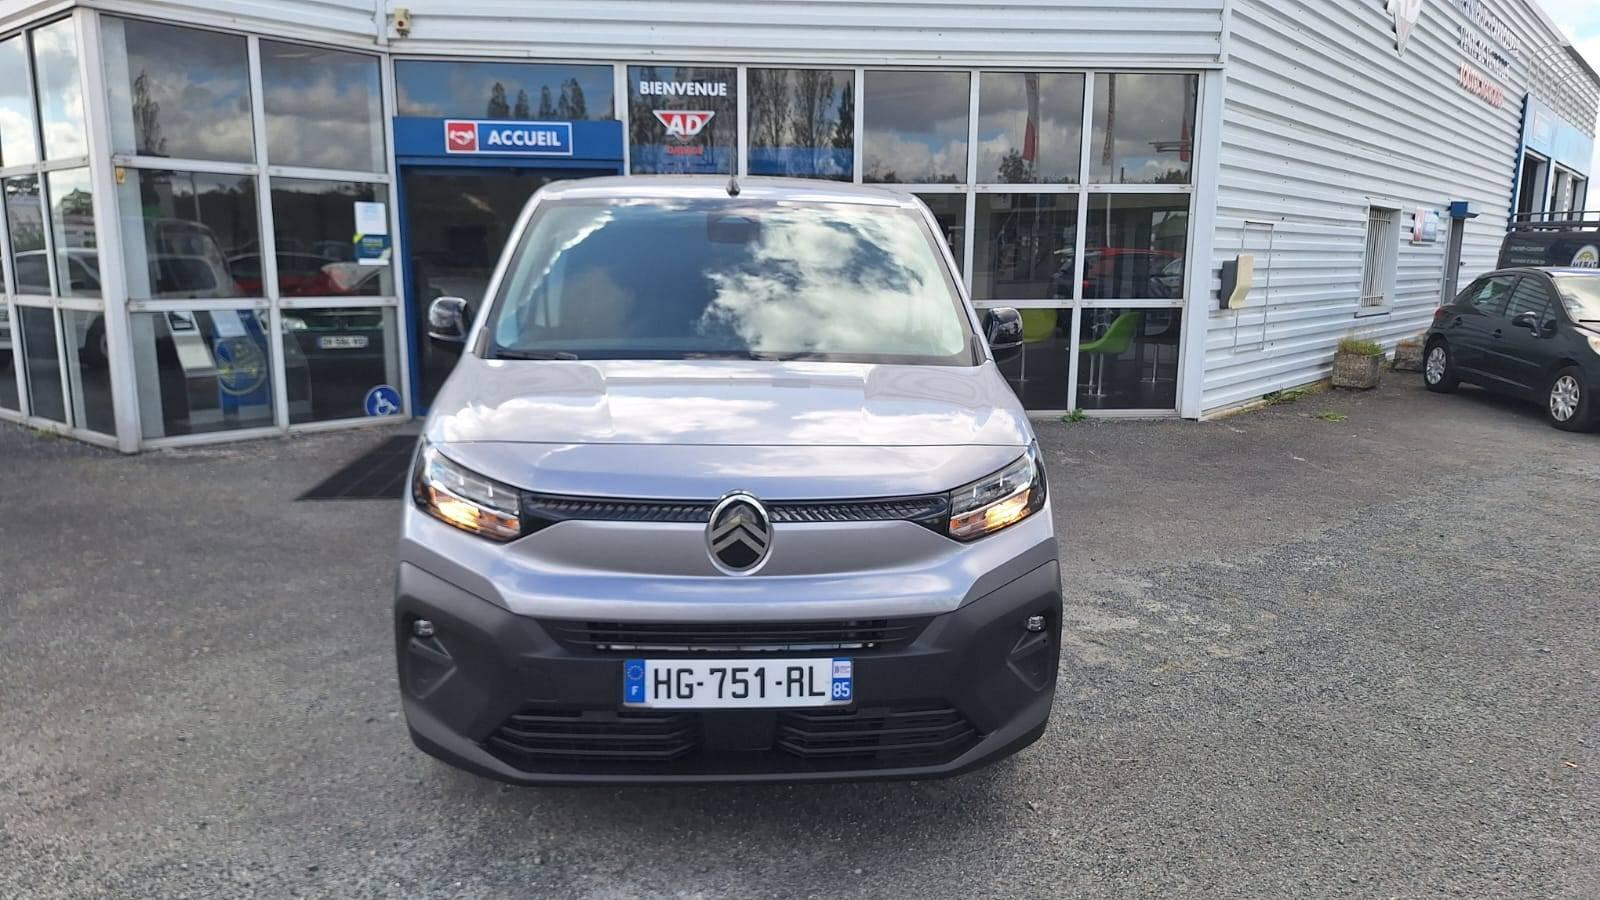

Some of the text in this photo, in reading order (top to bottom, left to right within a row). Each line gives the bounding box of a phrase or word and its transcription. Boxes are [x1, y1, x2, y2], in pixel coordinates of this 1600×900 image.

[640, 81, 727, 96] BIENVENUE
[666, 115, 702, 135] AD
[488, 130, 561, 147] ACCUEIL
[632, 686, 638, 695] F
[654, 666, 826, 699] HG-751-RL
[833, 682, 850, 697] 85
